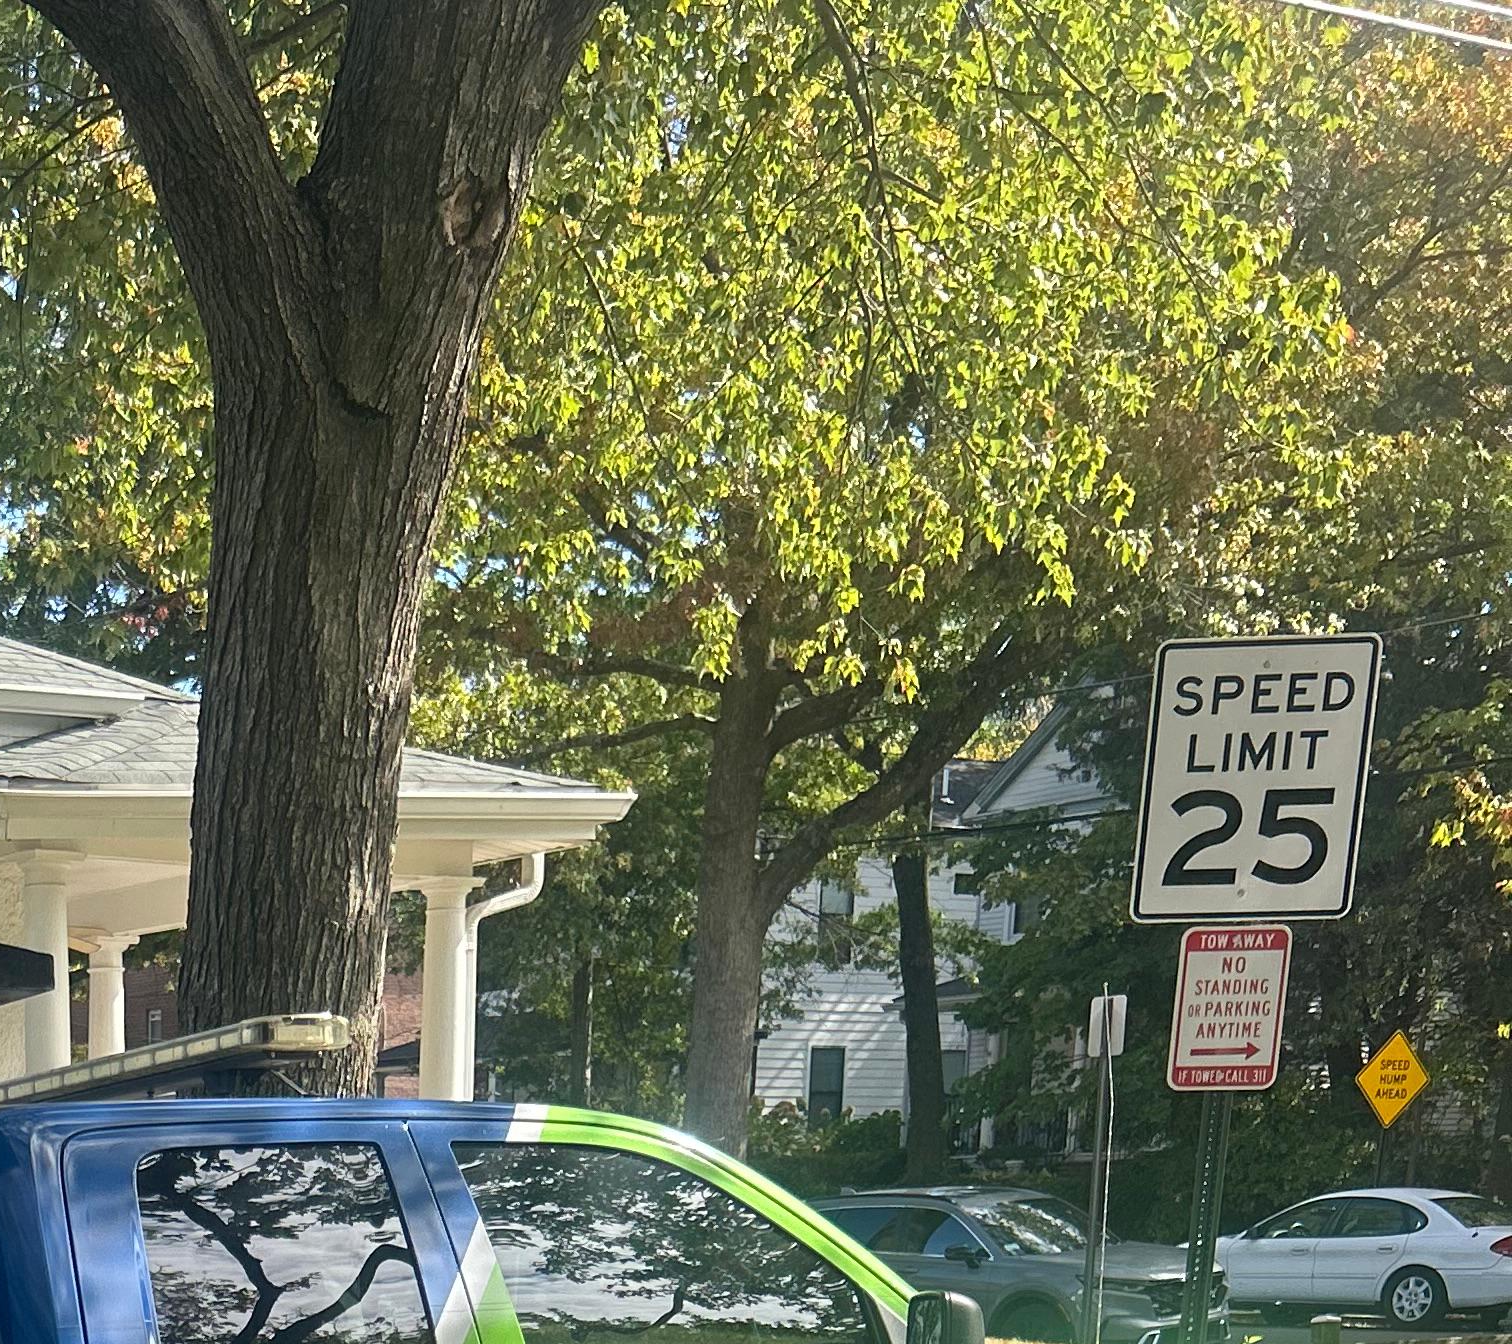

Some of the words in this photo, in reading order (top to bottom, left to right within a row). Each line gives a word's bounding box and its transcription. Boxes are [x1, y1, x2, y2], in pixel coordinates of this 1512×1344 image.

[1172, 671, 1356, 718] SPEED
[1186, 729, 1330, 775] LIMIT
[1160, 786, 1337, 887] 25
[1200, 934, 1229, 949] TOW
[1231, 933, 1275, 948] AWAY
[1221, 956, 1247, 974] NO
[1194, 978, 1270, 996] STANDING
[1188, 1004, 1201, 1018] OR
[1204, 1000, 1271, 1018] PARKING
[1195, 1021, 1262, 1039] ANYTIME
[1379, 1059, 1410, 1071] SPEED
[1178, 1071, 1188, 1083] IF
[1191, 1070, 1223, 1084] TOWED
[1225, 1070, 1249, 1083] CALL
[1253, 1069, 1267, 1083] 311
[1379, 1074, 1407, 1085] HUMP
[1374, 1088, 1408, 1099] AHEAD
